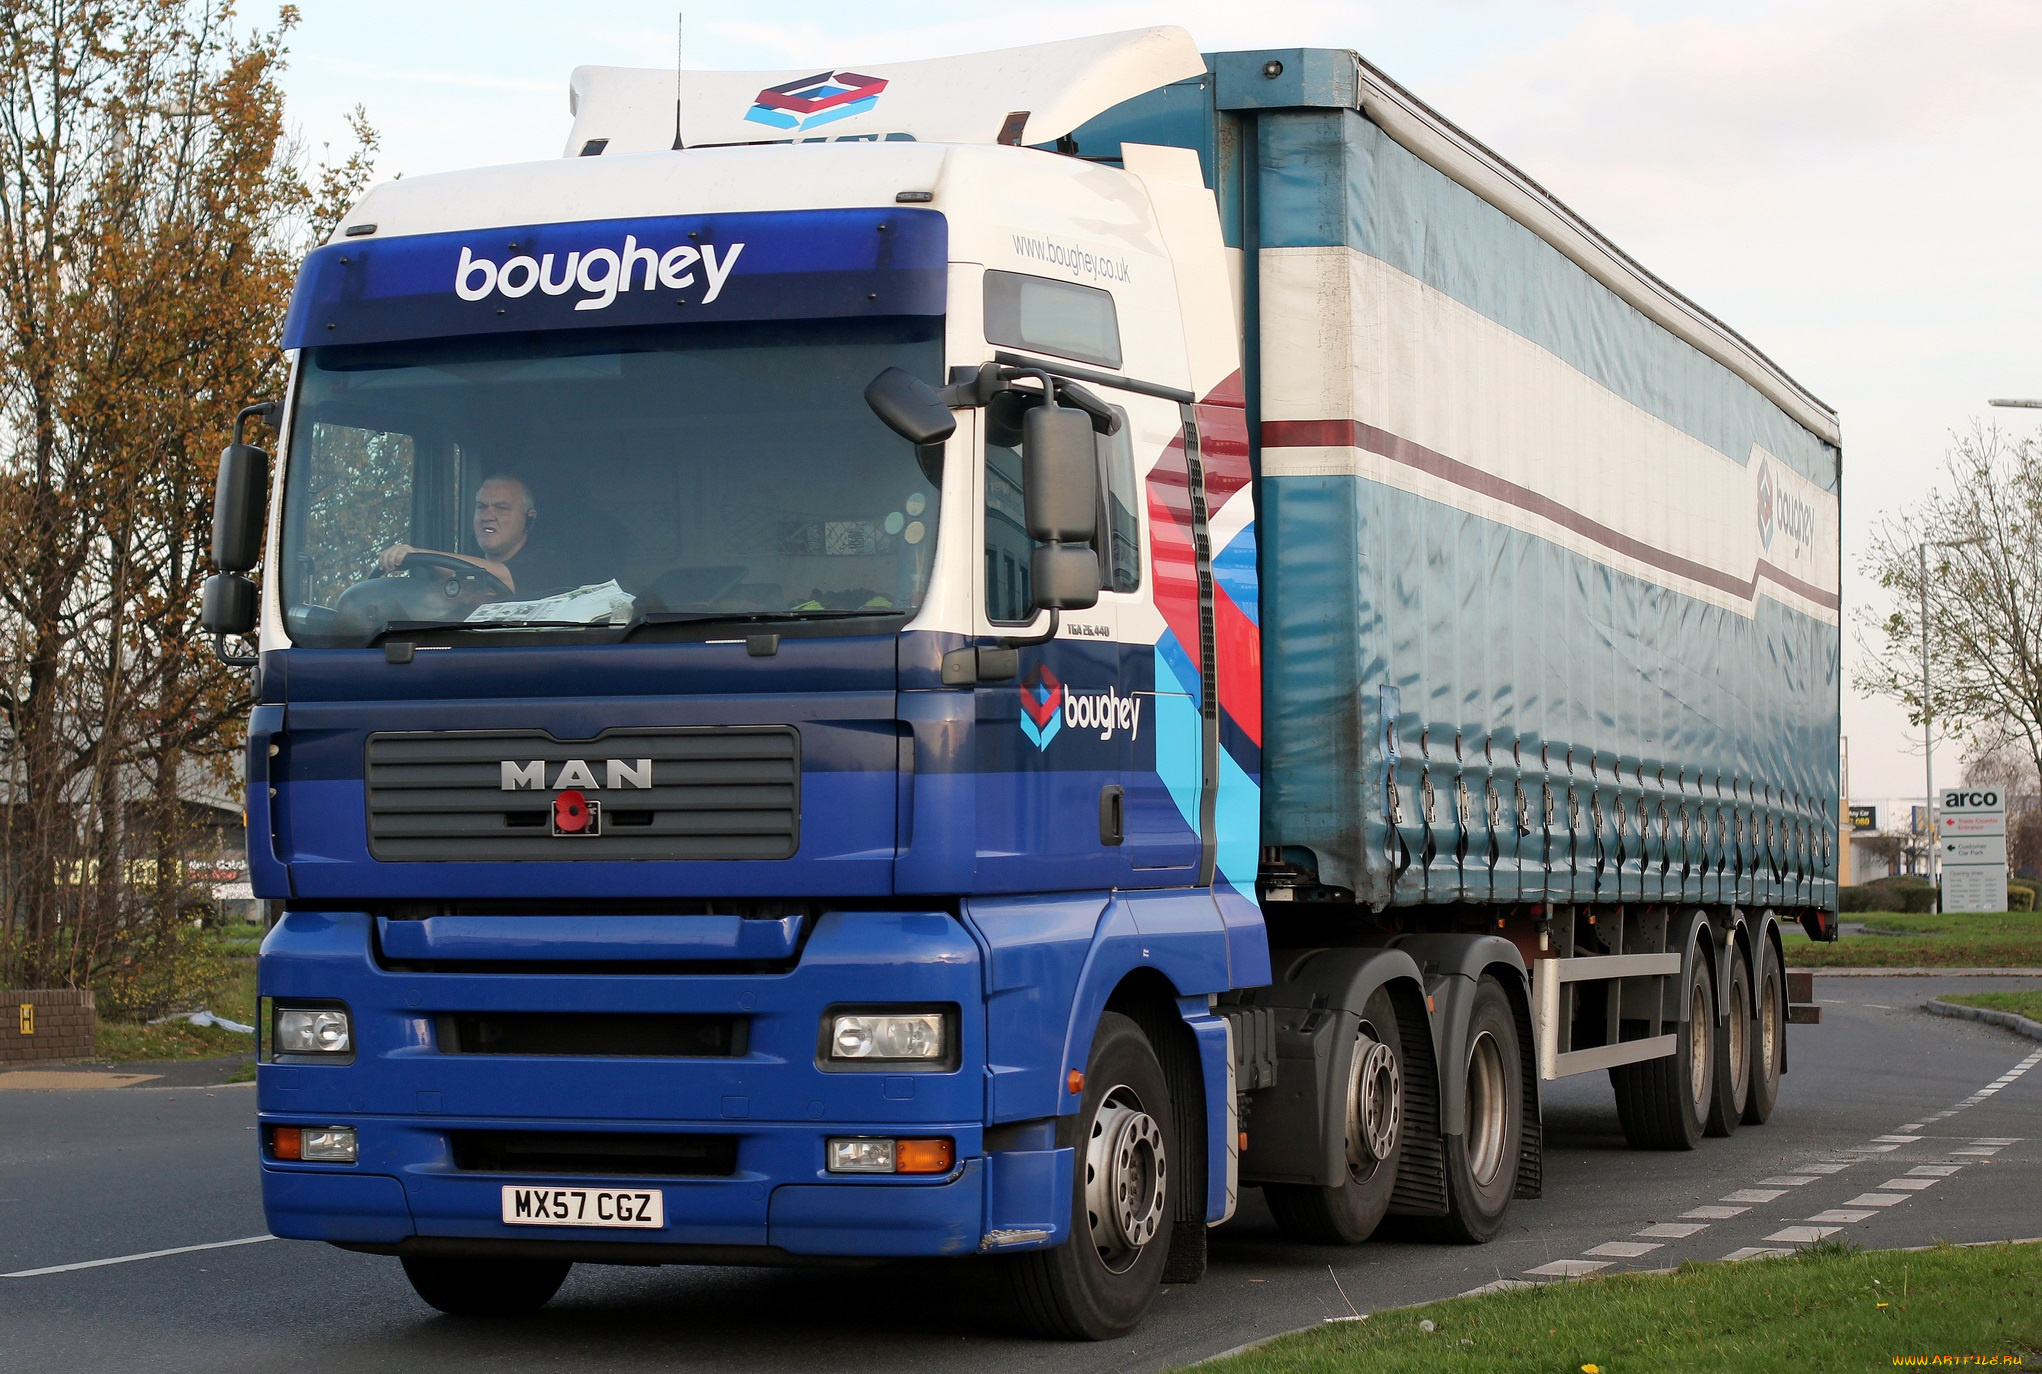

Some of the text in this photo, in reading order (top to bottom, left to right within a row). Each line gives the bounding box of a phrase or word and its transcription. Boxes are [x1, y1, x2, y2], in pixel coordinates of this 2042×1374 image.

[454, 234, 746, 312] boughey
[1012, 234, 1131, 283] www.boughey.co.uk
[1776, 469, 1815, 567] boughey
[1067, 623, 1082, 636] TGA
[1064, 683, 1141, 742] boughey
[500, 758, 653, 791] MAN
[1945, 791, 1998, 808] arco
[21, 1007, 32, 1031] H
[514, 1189, 652, 1222] MX57 CGZ
